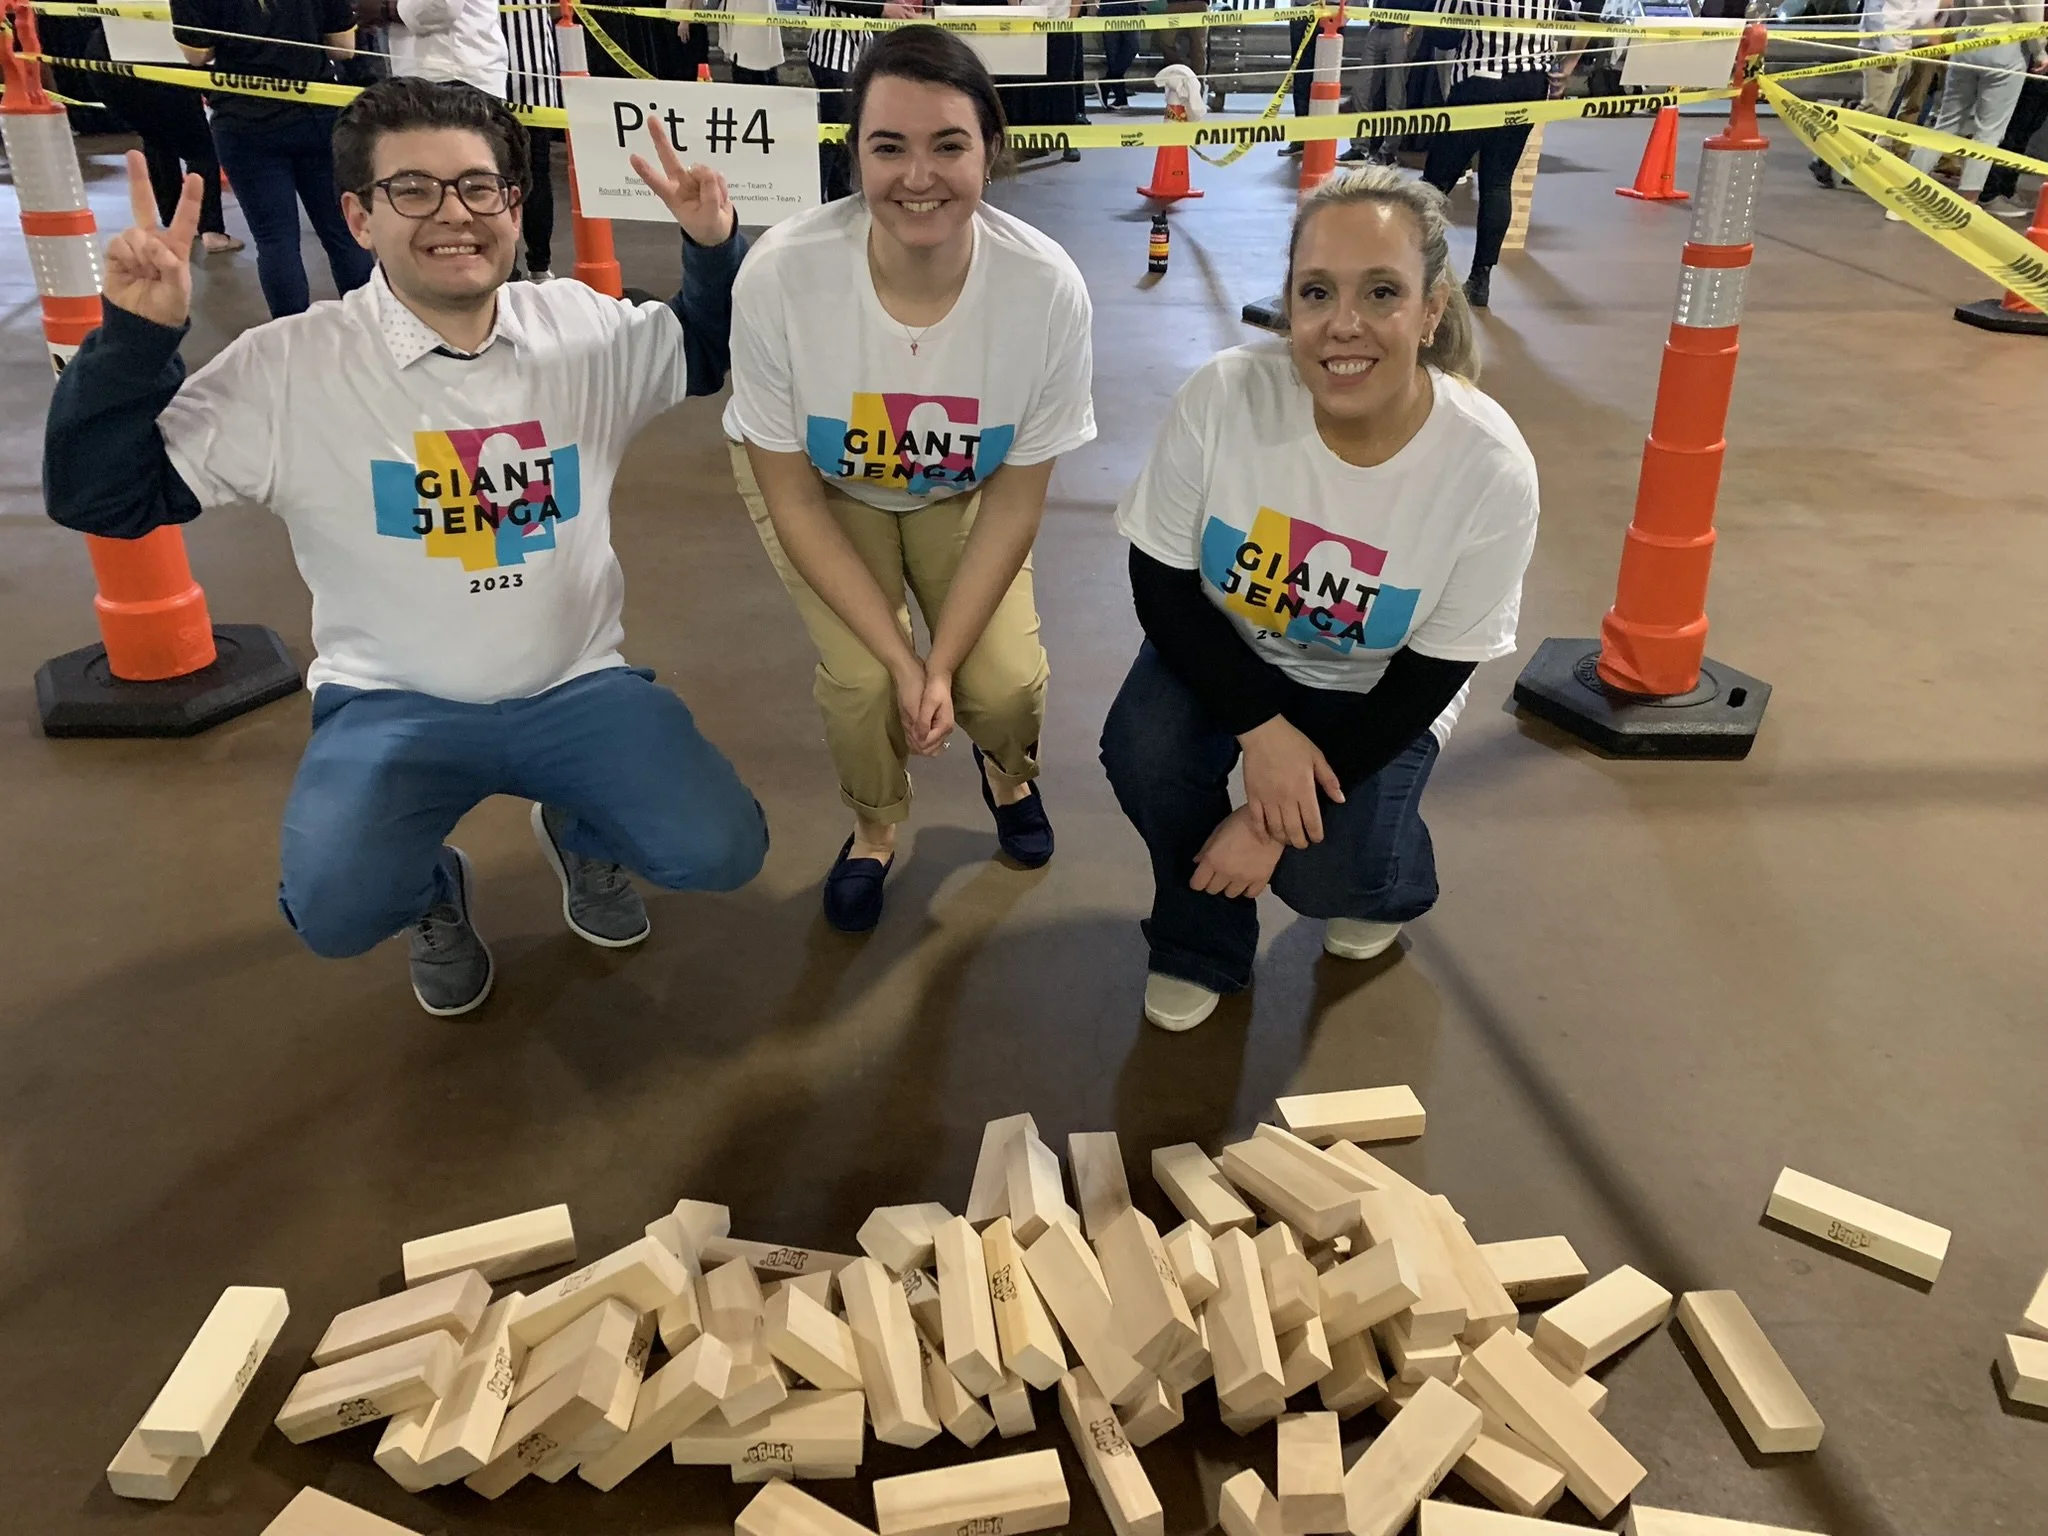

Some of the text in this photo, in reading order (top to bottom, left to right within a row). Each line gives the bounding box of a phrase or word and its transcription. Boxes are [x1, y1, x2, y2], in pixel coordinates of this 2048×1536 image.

[1859, 56, 1898, 68] CAUTION
[613, 101, 775, 154] Pt #4
[1195, 125, 1285, 145] CAUTION
[1356, 112, 1451, 138] CUIDADO
[1581, 95, 1677, 117] CAUTION
[729, 194, 769, 202] onstruction
[843, 428, 982, 460] GIANT
[414, 457, 554, 499] GIANT
[836, 458, 977, 482] JENGA
[412, 494, 561, 535] JENGA
[469, 573, 524, 594] 2023
[1235, 541, 1380, 613] GIANT
[1220, 567, 1366, 645] JENGA
[1256, 629, 1308, 650] 203
[1828, 1220, 1871, 1248] Jenga
[766, 1247, 809, 1269] Jenga
[992, 1263, 1017, 1303] Jenga
[487, 1351, 513, 1401] Jenga
[746, 1441, 794, 1464] Jenga
[1090, 1416, 1130, 1457] Jenga
